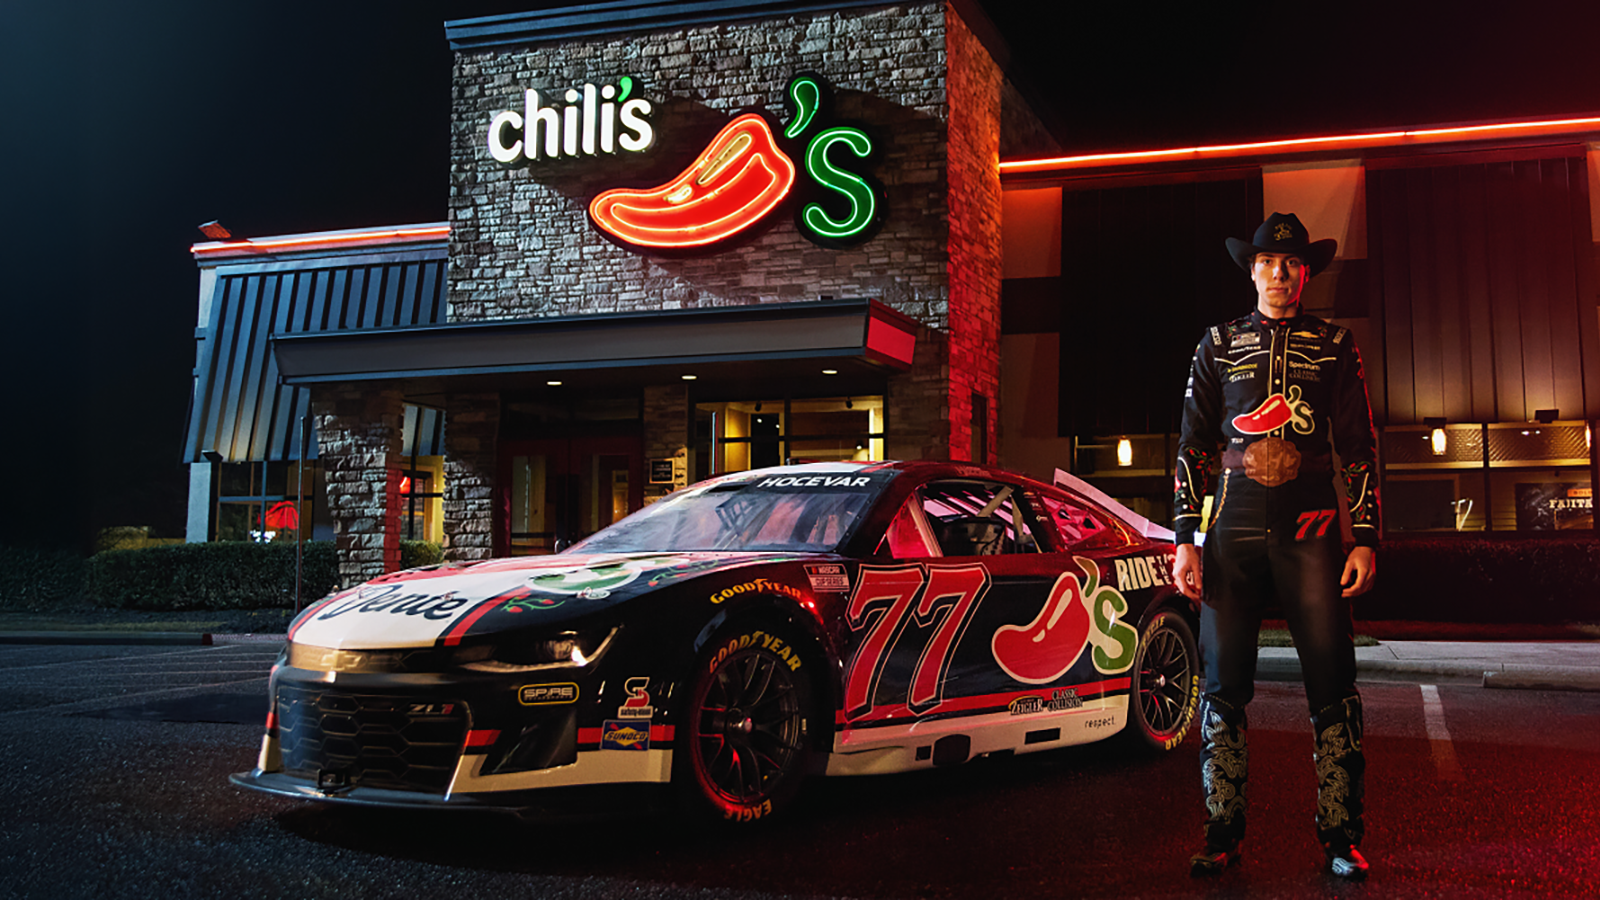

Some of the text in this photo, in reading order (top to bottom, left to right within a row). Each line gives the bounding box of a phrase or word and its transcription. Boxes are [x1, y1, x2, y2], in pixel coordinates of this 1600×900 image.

[488, 76, 653, 163] chili's
[757, 476, 871, 488] HOCEVAR
[1295, 509, 1337, 540] 77
[1114, 556, 1165, 592] RIDE
[710, 578, 801, 604] GOODYEAR
[709, 630, 802, 674] GOODYEAR
[845, 563, 992, 723] 77
[1010, 698, 1044, 716] ZEIGLER
[1051, 688, 1079, 700] CLASSIC
[407, 704, 454, 715] ZL1
[1165, 675, 1199, 750] GOODYEAR
[606, 731, 647, 741] SUNOCO
[724, 799, 773, 822] EAGLE
